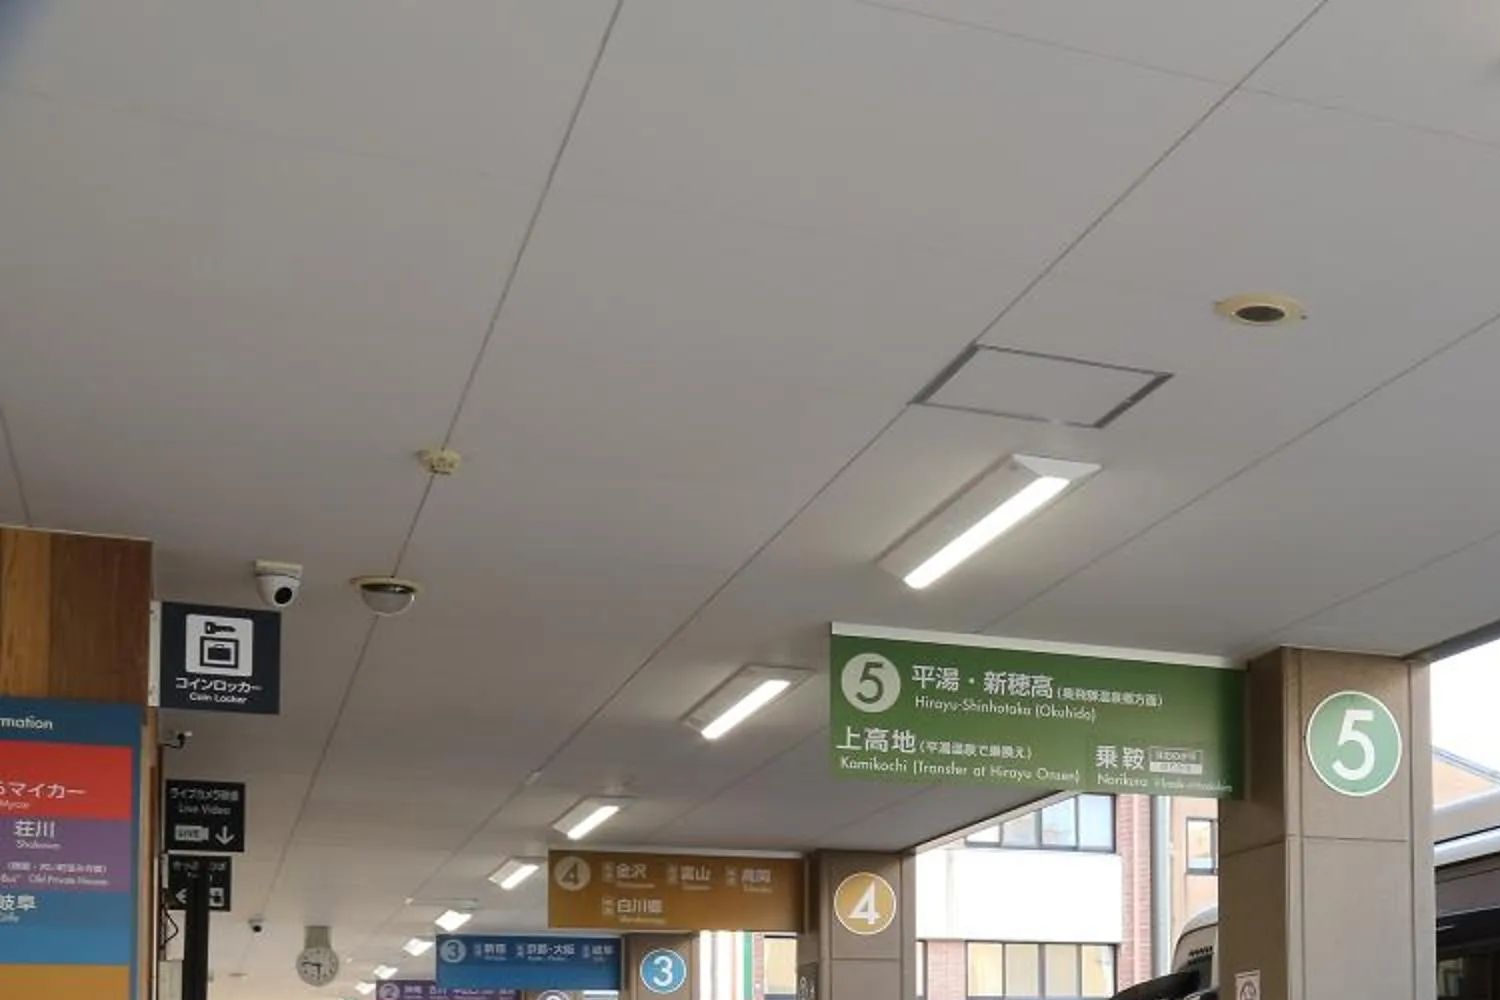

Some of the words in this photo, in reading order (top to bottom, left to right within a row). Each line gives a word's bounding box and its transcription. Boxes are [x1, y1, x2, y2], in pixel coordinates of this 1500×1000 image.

[175, 677, 264, 693] コインロッカー
[856, 661, 884, 704] 5
[911, 665, 1053, 698] 平湯・新穂高
[189, 691, 212, 702] Coin
[214, 693, 248, 704] Locker
[1035, 702, 1097, 724] (Okuhida)
[836, 726, 916, 754] 上高地
[1330, 708, 1375, 781] 5
[840, 755, 907, 771] Kamikochi
[912, 758, 967, 776] (Transfer
[972, 766, 985, 777] at
[989, 766, 1032, 783] Hirayu
[1095, 746, 1145, 771] 乗鞍
[1097, 773, 1149, 788] Norikura
[202, 804, 232, 815] Video
[14, 819, 56, 839] 荘川
[560, 861, 580, 886] 4
[616, 863, 648, 880] 金沢
[848, 880, 880, 925] 4
[652, 955, 674, 987] 3
